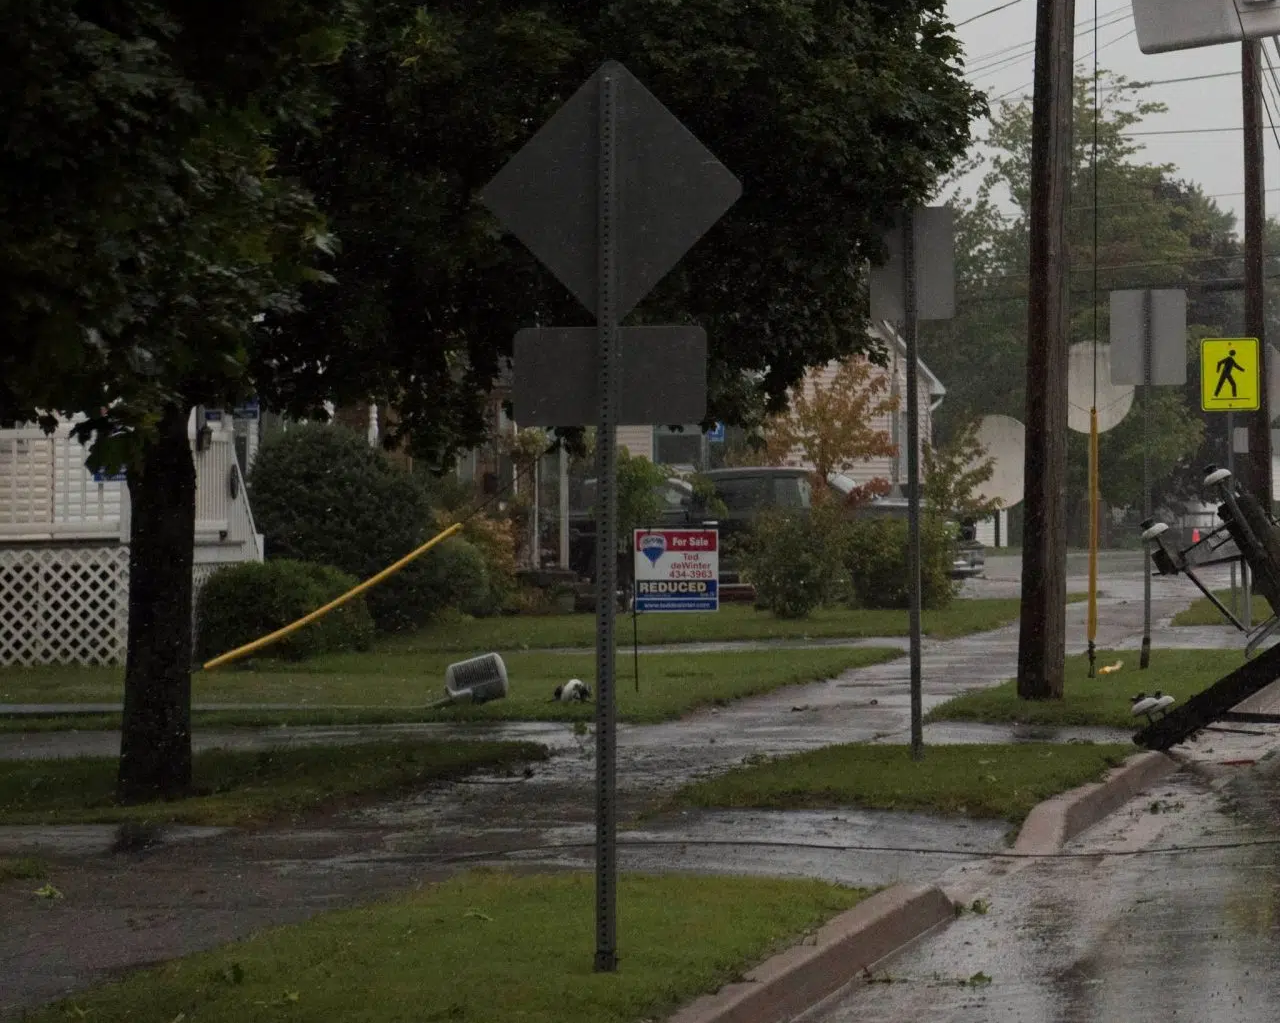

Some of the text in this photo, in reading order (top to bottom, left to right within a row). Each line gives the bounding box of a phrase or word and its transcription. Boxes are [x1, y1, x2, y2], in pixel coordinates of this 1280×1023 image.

[672, 537, 709, 547] For Sale
[671, 561, 711, 570] deWinter
[669, 570, 713, 579] 434-3963
[639, 582, 707, 593] REDUCED
